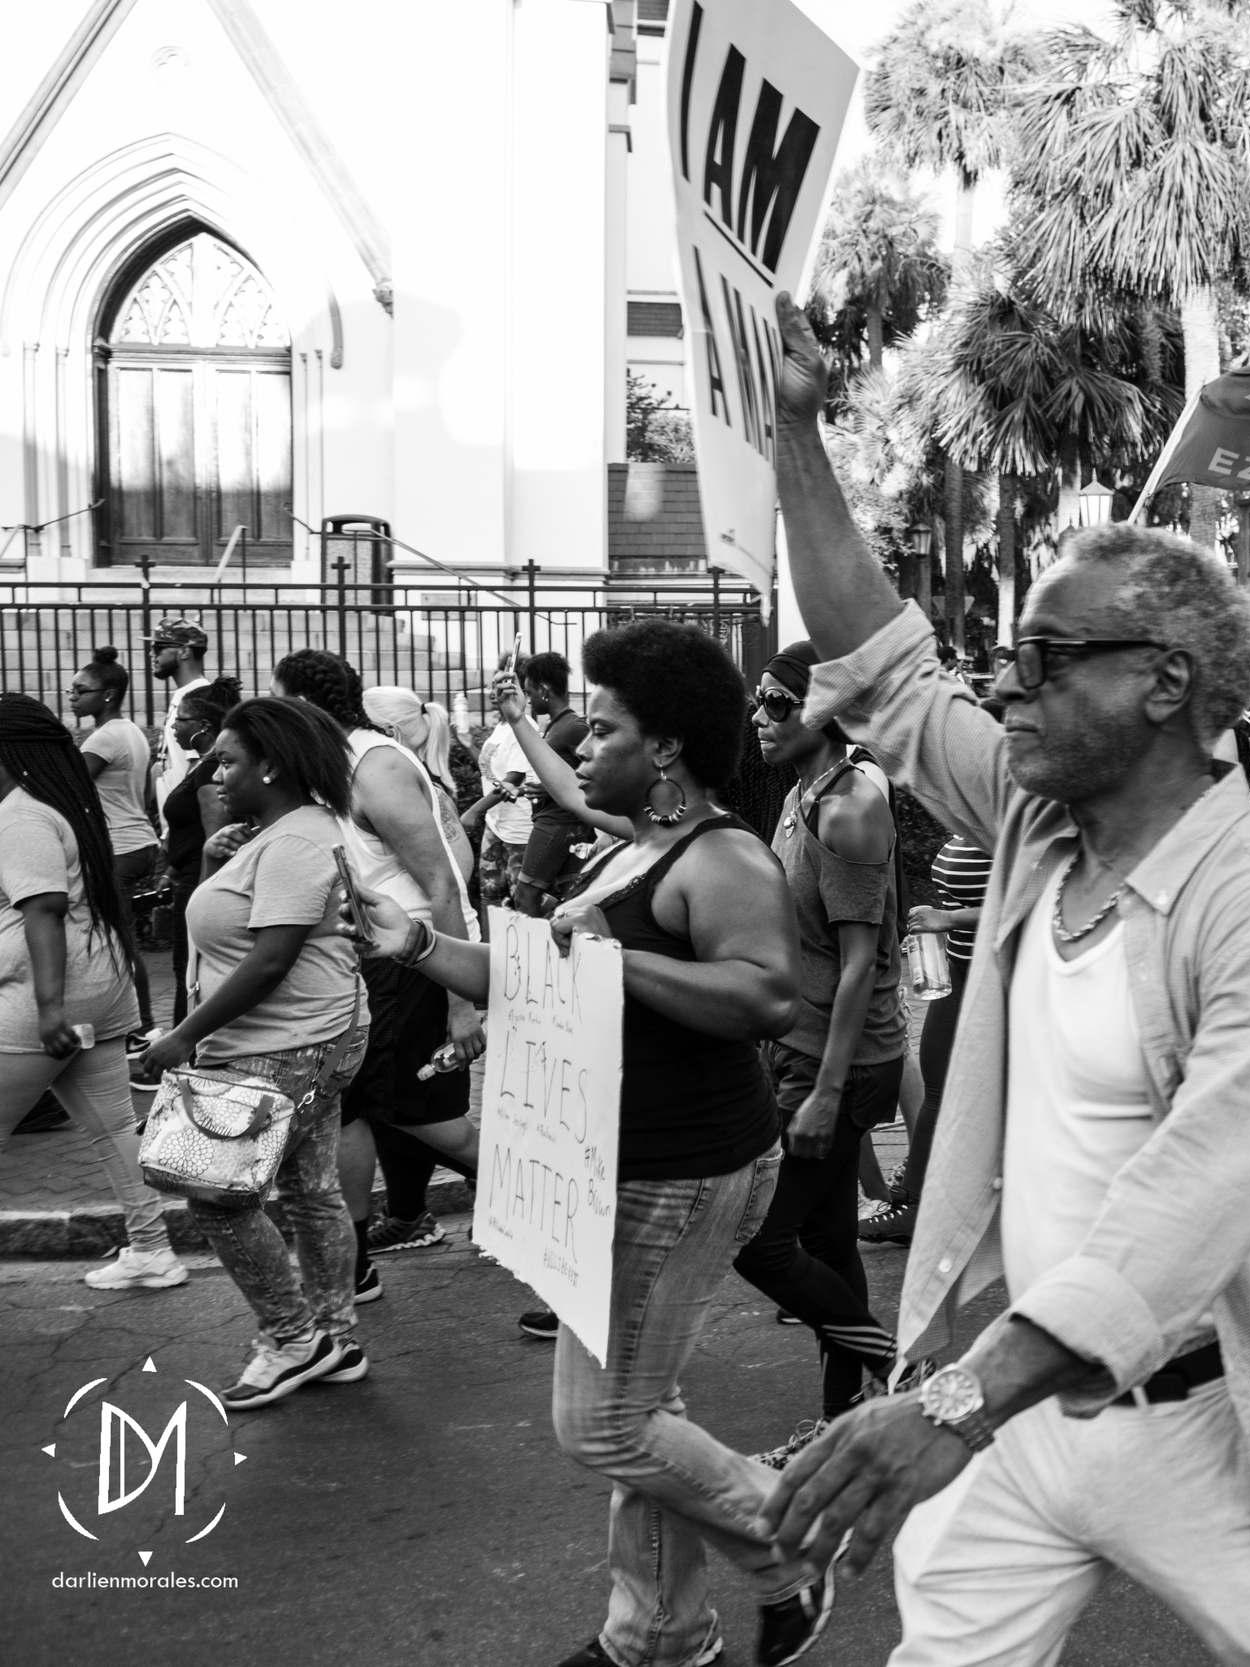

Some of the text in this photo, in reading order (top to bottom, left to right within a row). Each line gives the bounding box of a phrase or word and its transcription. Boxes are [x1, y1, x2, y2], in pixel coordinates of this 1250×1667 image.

[703, 42, 822, 276] AM
[504, 923, 583, 1026] BLACK
[500, 1029, 588, 1143] LIVES
[488, 1143, 579, 1265] MATTER
